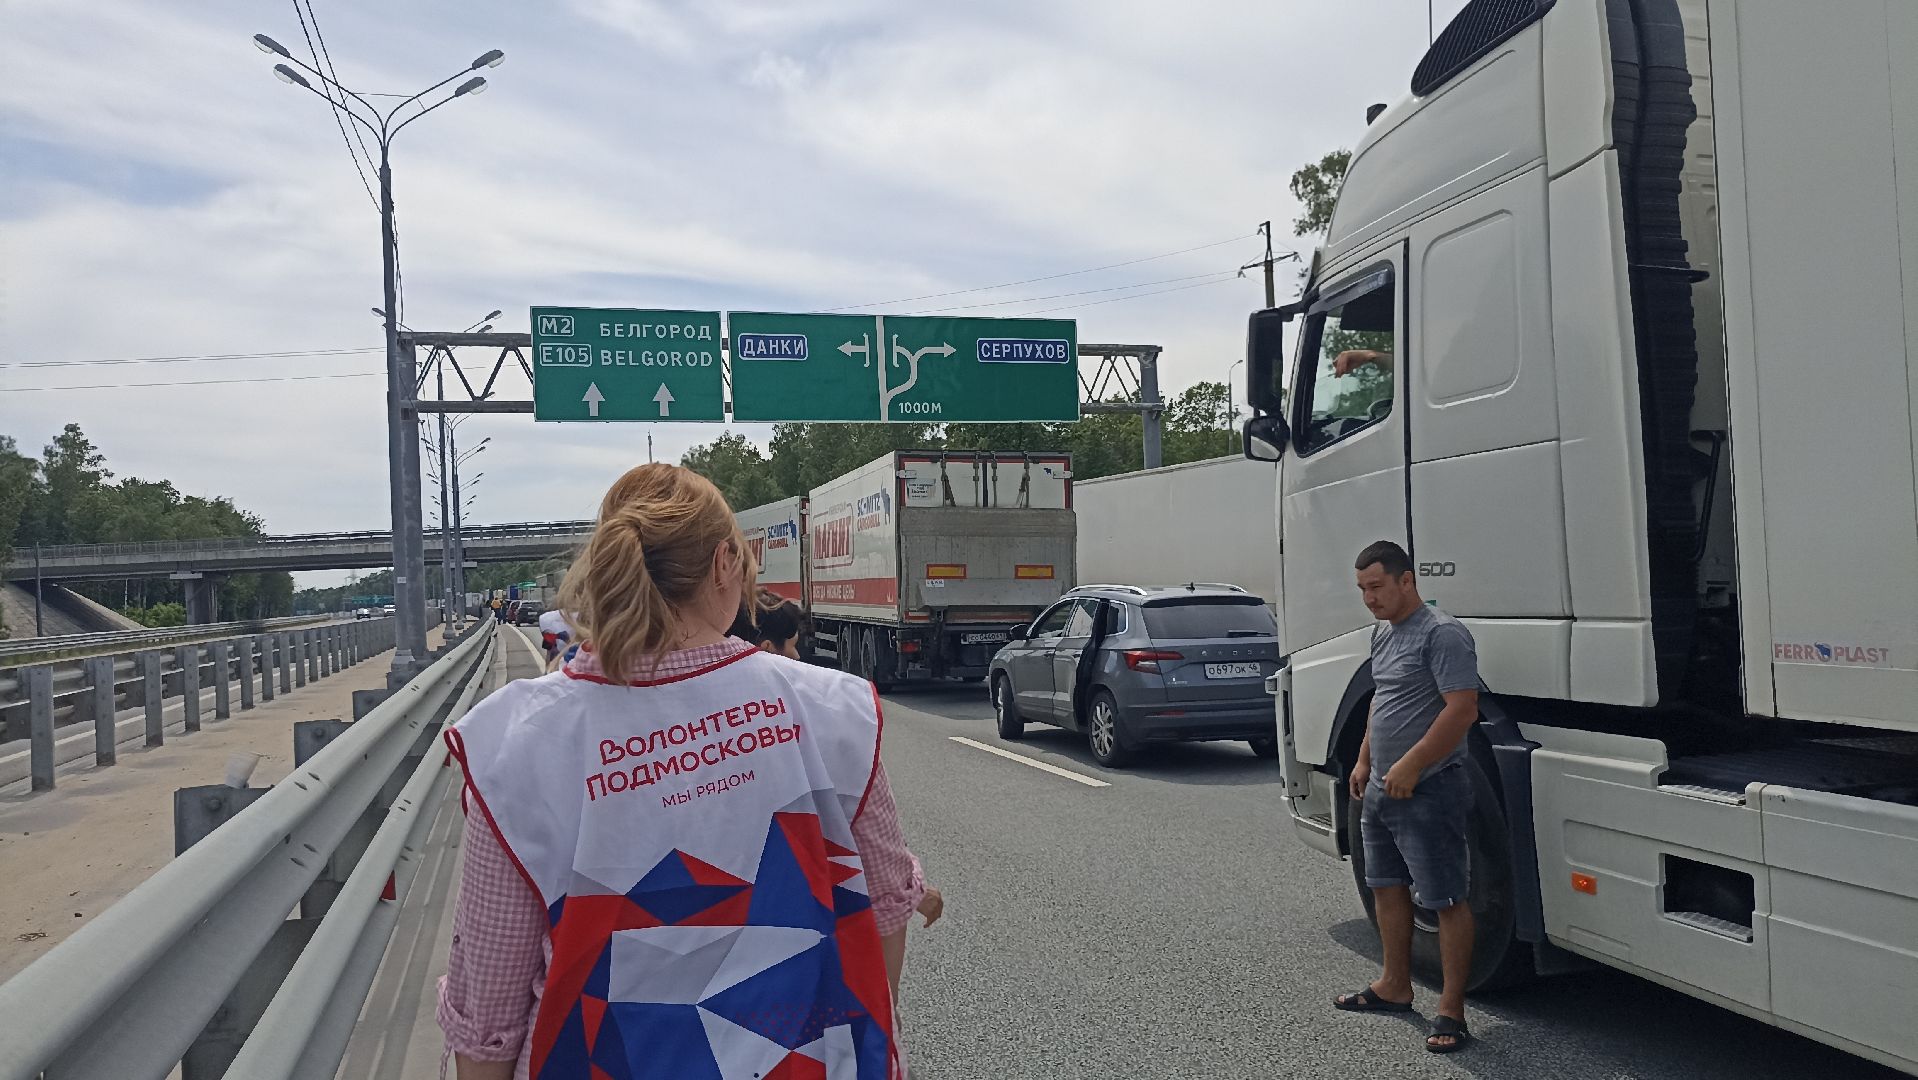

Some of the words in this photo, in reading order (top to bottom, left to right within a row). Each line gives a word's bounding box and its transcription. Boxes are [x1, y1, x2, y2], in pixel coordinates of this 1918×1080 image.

[541, 317, 572, 335] М2
[599, 323, 713, 342] БЕЛГОРОД
[541, 345, 590, 364] E105
[743, 338, 805, 358] ДАНКИ
[980, 341, 1066, 360] СЕРПУХОВ
[600, 349, 714, 368] BELGOROD
[813, 516, 851, 560] МАГНИТ
[1418, 561, 1456, 577] 500
[599, 697, 787, 766] ВОЛОНТЕРЫ
[661, 789, 692, 808] МЫ
[696, 769, 756, 798] РЯДОМ
